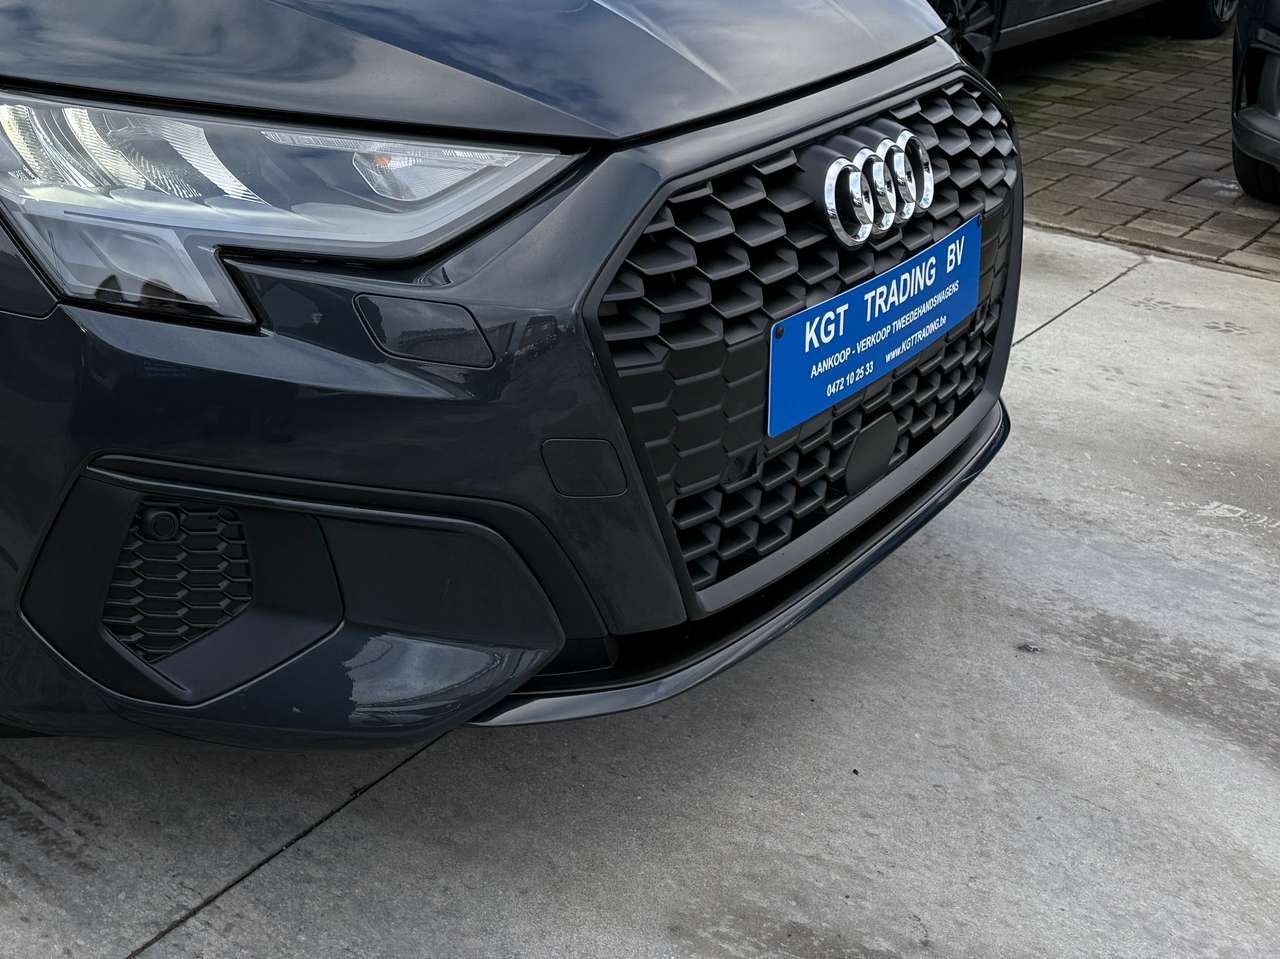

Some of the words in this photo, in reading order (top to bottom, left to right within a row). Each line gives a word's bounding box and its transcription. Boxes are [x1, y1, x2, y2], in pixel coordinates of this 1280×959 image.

[804, 304, 849, 353] KGT
[864, 256, 936, 322] TRADING
[946, 235, 965, 274] BV
[810, 348, 852, 379] AANKOOP
[856, 325, 891, 354] VERKOOP
[891, 280, 960, 335] TWEEDEHANDSWAGENS
[826, 377, 845, 398] 0472
[846, 369, 855, 386] 10
[855, 365, 865, 382] 25
[864, 360, 874, 375] 33
